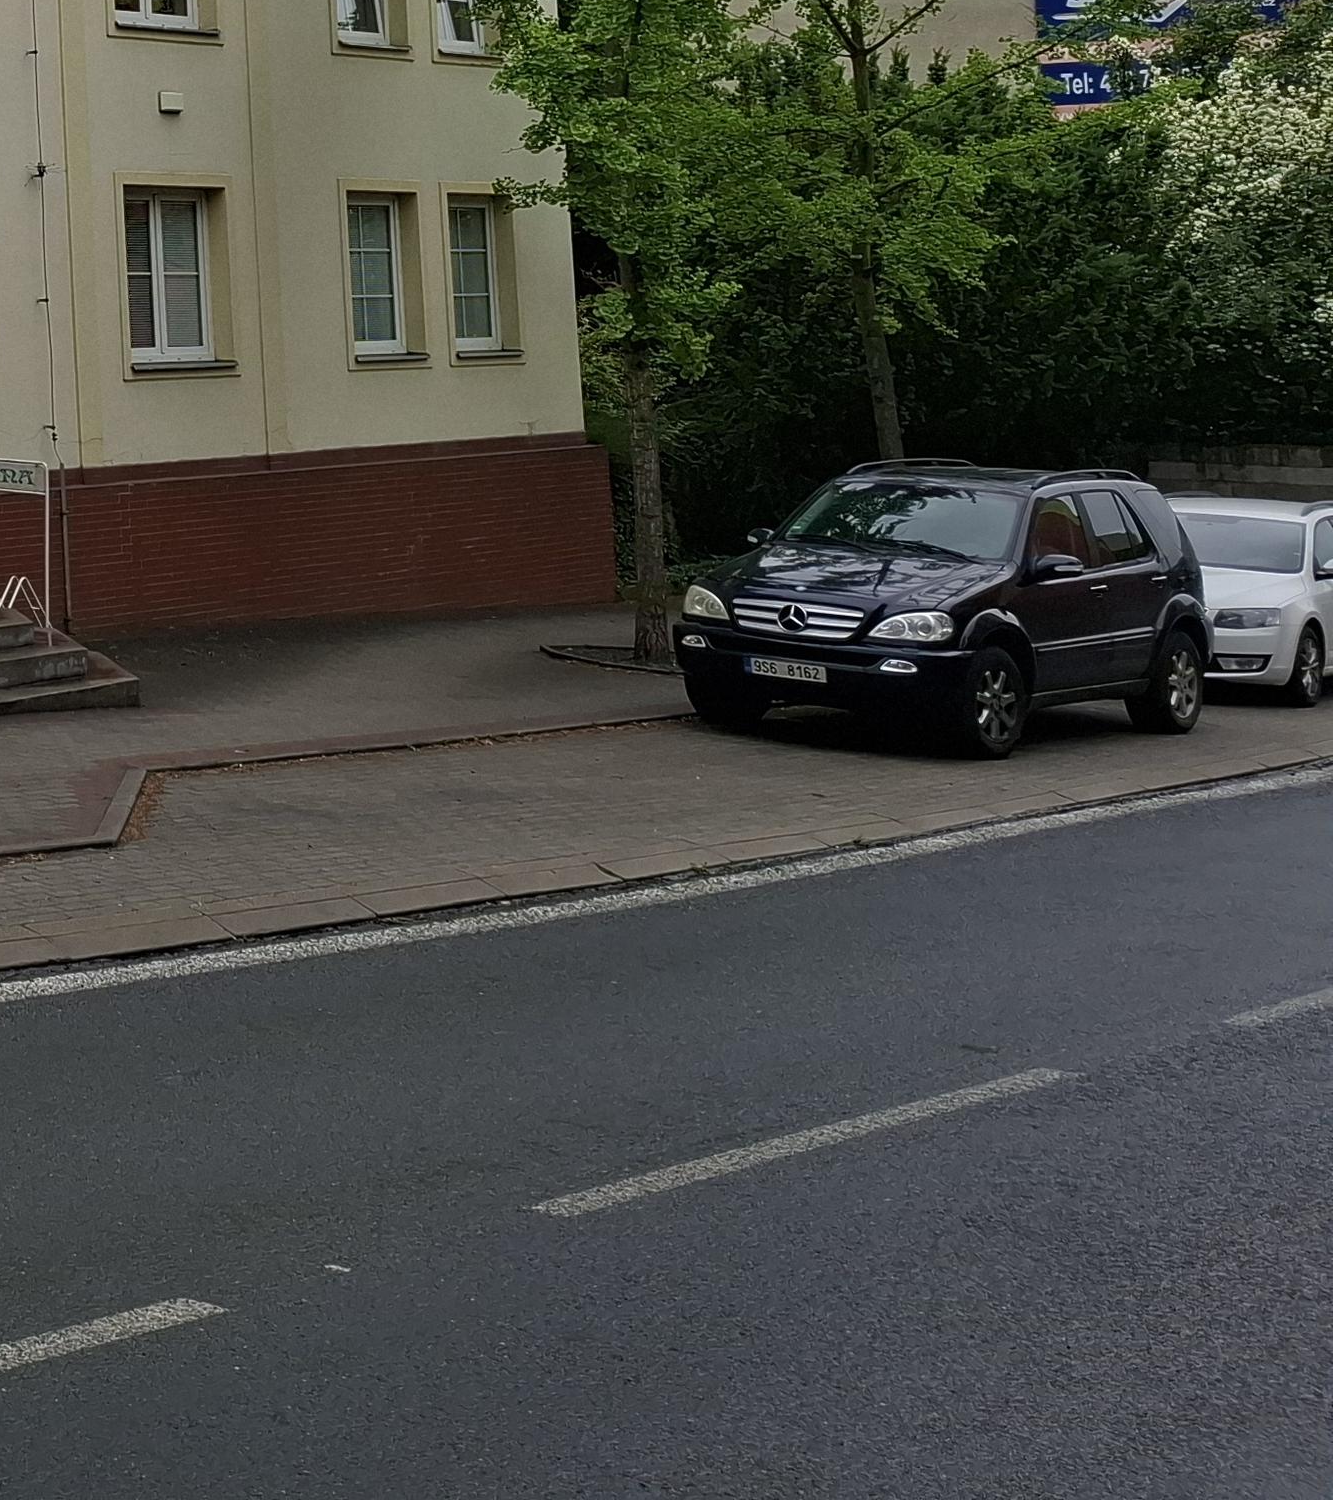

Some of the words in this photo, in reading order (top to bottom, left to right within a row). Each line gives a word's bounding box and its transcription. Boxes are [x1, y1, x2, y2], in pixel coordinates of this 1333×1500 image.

[1060, 72, 1094, 95] Tel:
[753, 660, 778, 675] 9S6
[787, 664, 822, 680] 8162
